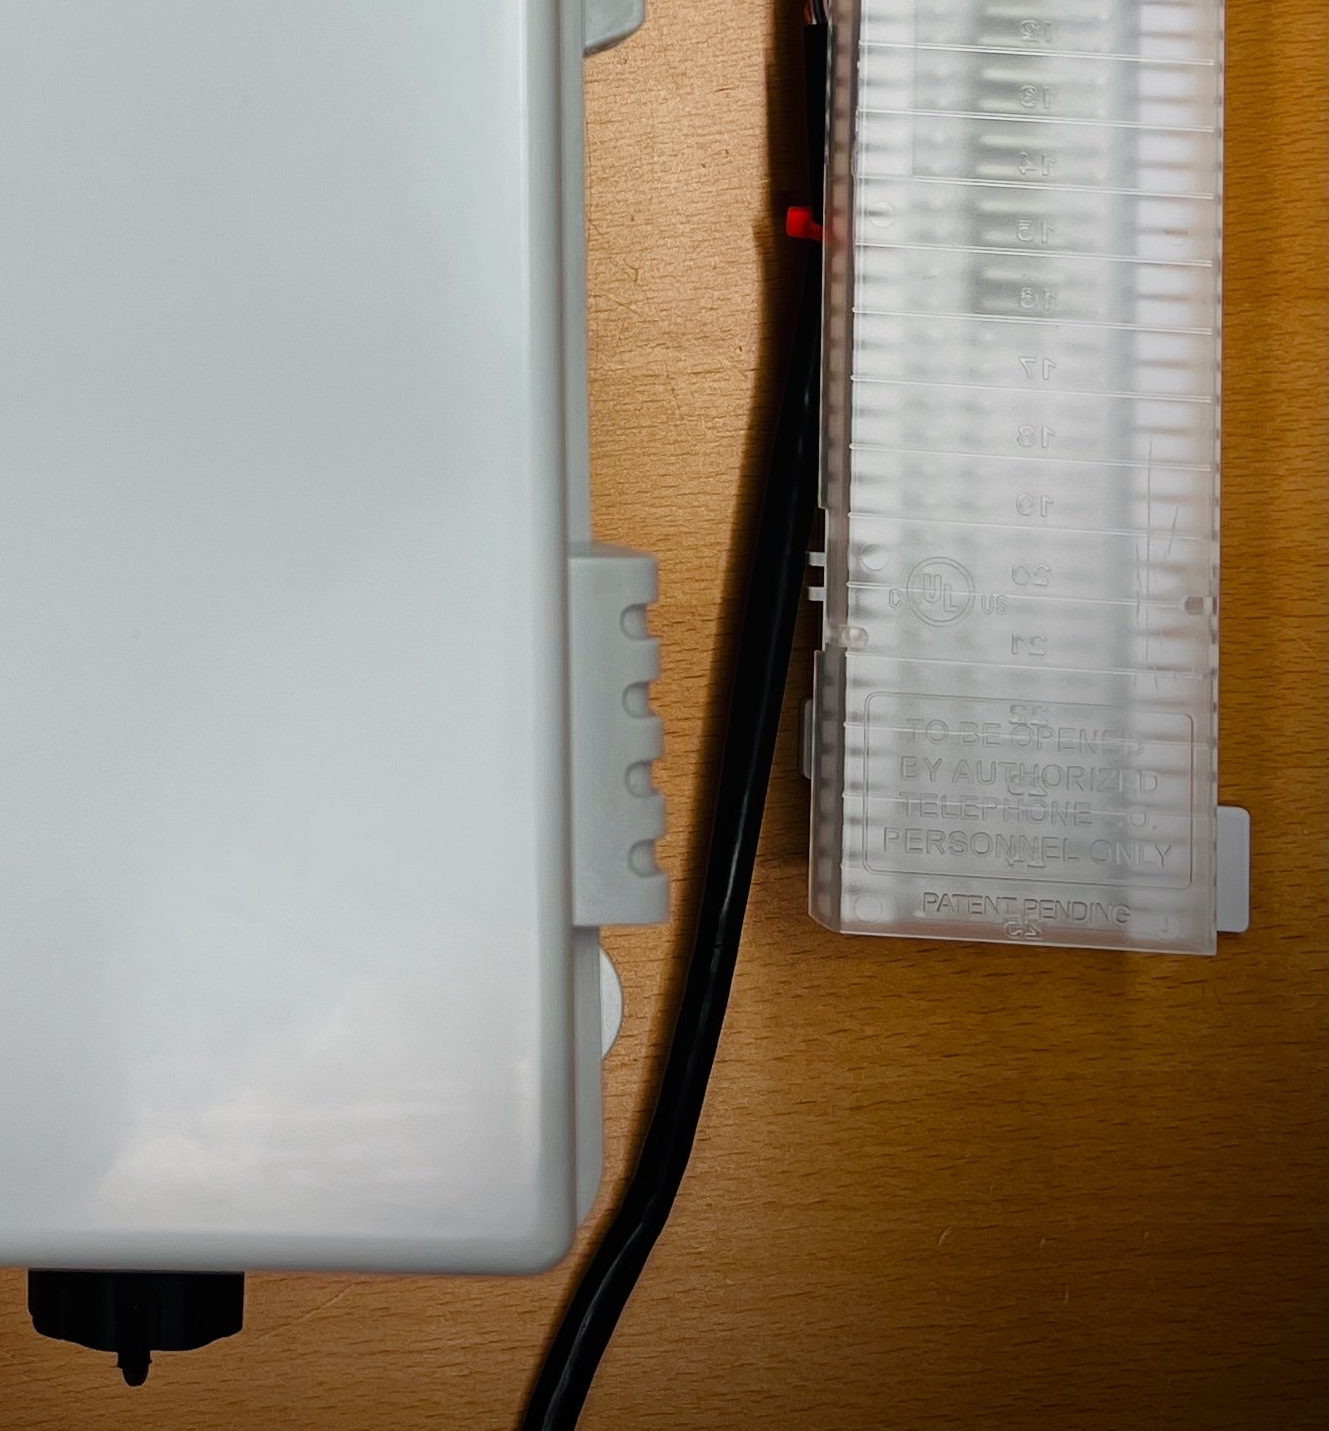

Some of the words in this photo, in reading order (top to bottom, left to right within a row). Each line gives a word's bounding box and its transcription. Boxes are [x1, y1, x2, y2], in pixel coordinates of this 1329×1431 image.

[906, 718, 950, 745] TO
[958, 721, 1002, 747] BE
[1010, 723, 1144, 756] OPENED
[899, 755, 943, 783] BY
[898, 790, 1094, 828] TELEPHONE
[882, 825, 1080, 864] PERSONNEL
[1091, 838, 1172, 869] ONLY
[921, 891, 1019, 917] PATENT
[1022, 897, 1132, 924] PENDING
